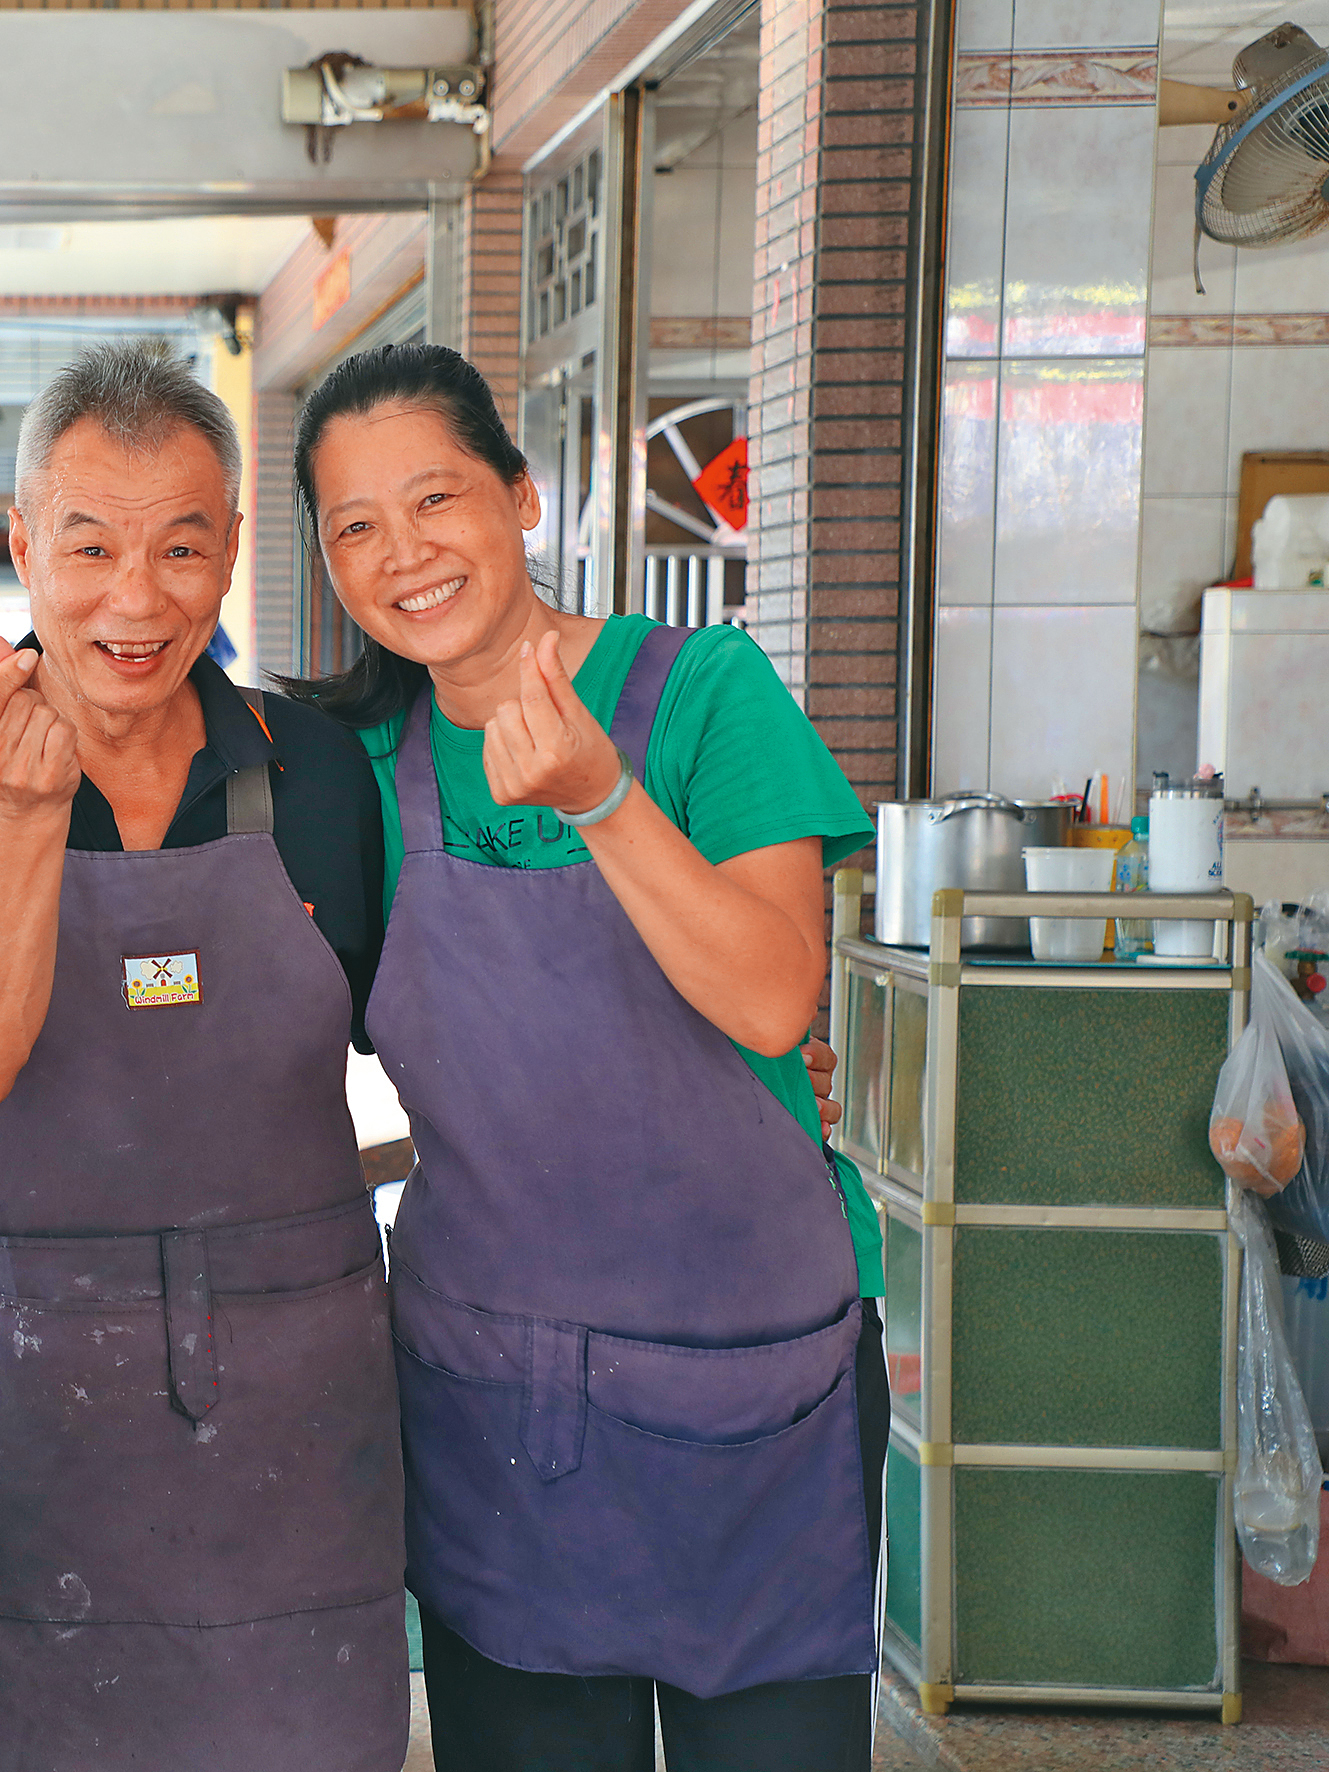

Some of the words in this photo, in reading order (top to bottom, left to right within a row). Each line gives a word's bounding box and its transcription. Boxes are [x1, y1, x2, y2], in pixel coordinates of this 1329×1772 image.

[460, 818, 525, 853] AKE
[537, 814, 571, 843] U
[134, 994, 170, 1004] Windmill
[171, 993, 194, 1002] Farm
